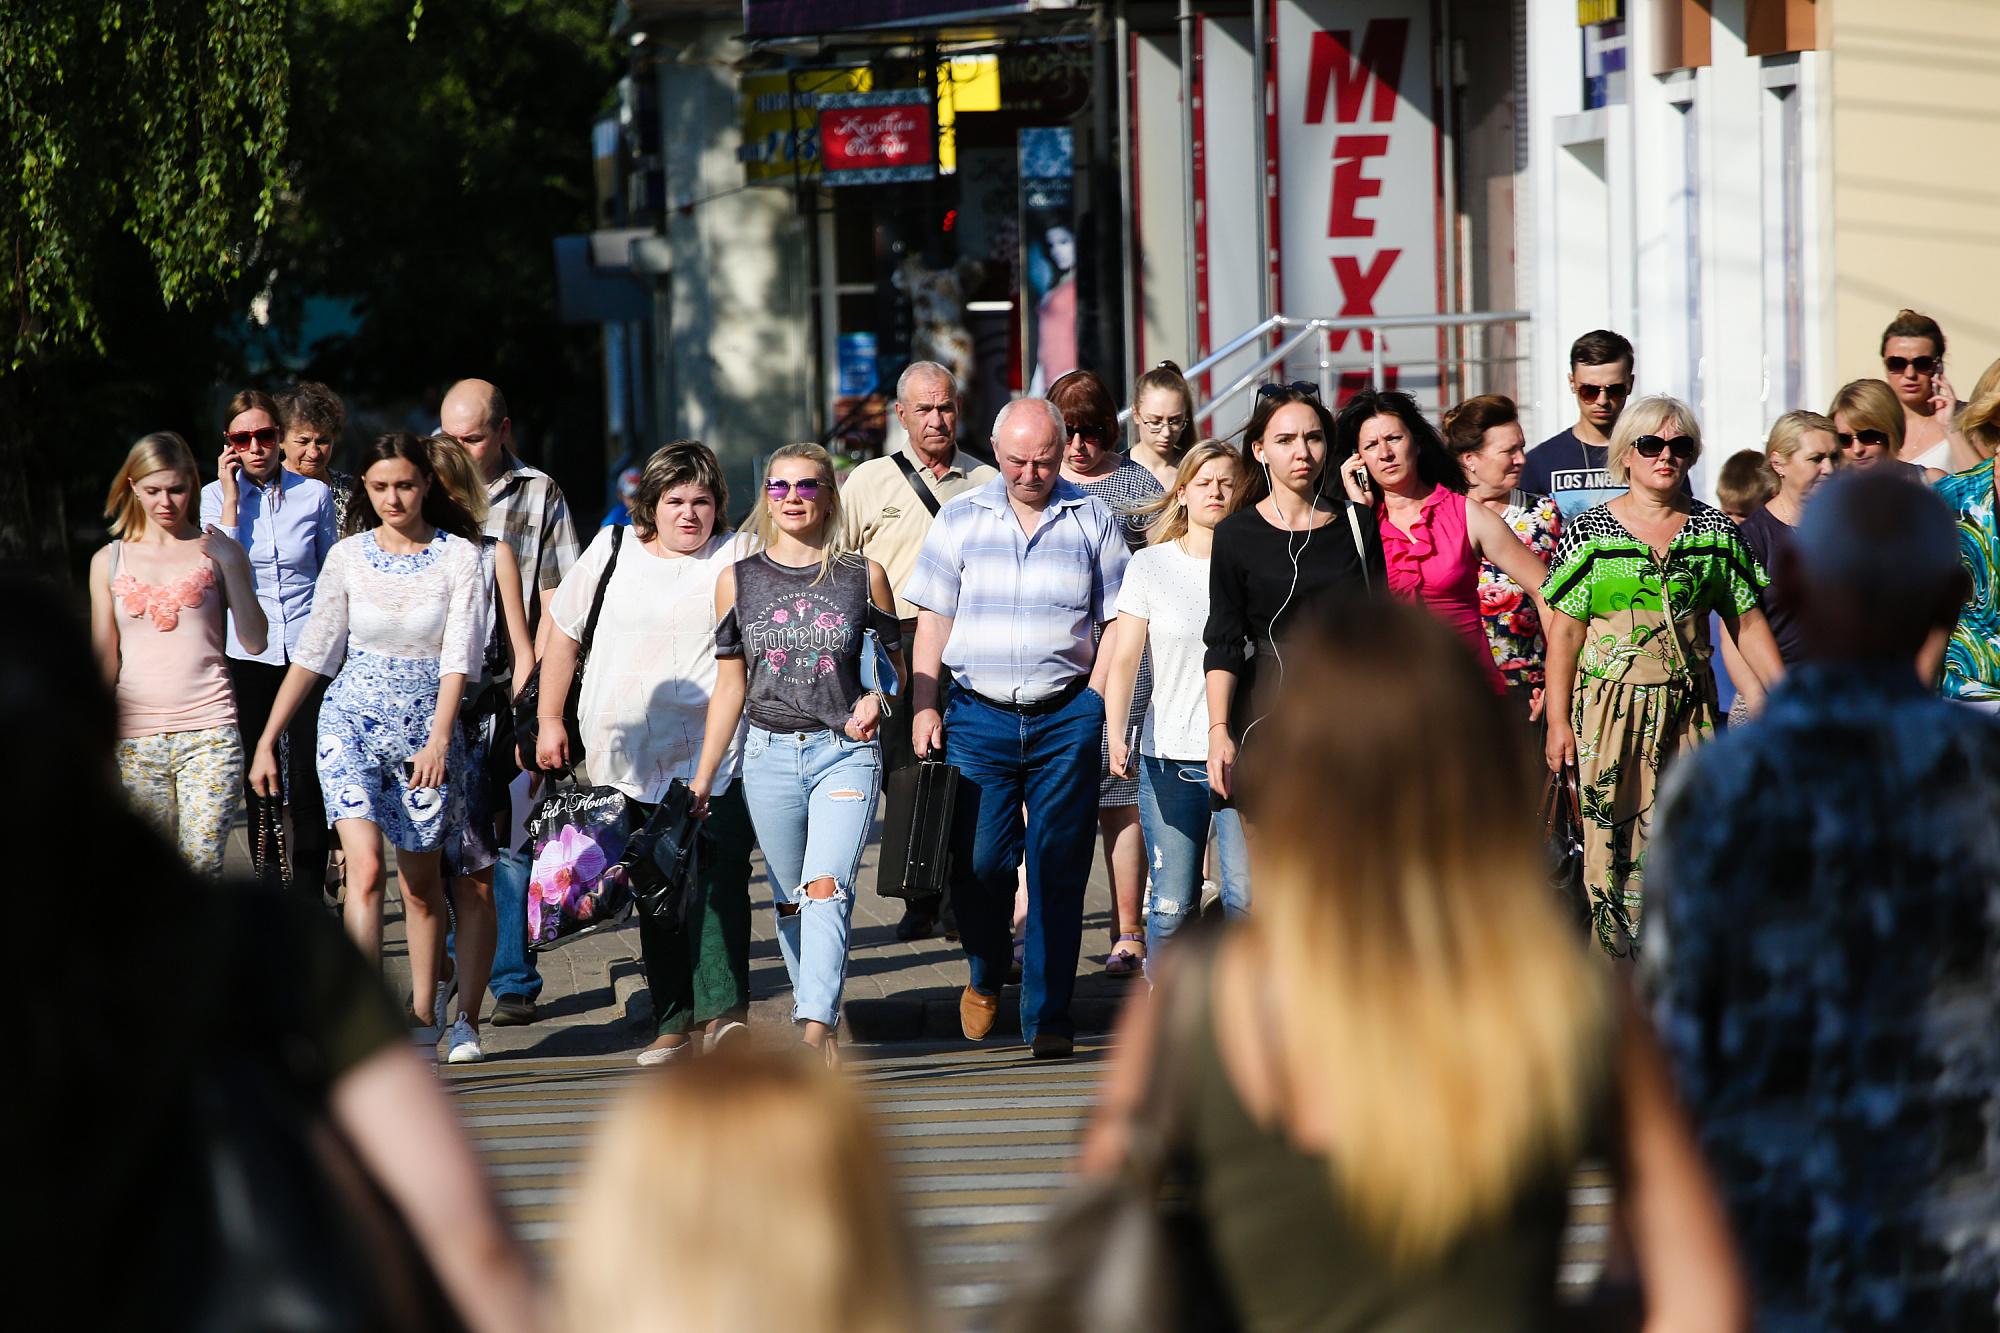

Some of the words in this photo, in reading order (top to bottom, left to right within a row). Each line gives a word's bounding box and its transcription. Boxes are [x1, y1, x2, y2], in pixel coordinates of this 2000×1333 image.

[1556, 474, 1582, 489] LOS
[1585, 472, 1629, 488] ANG
[746, 620, 852, 657] Forever
[795, 657, 809, 668] 95
